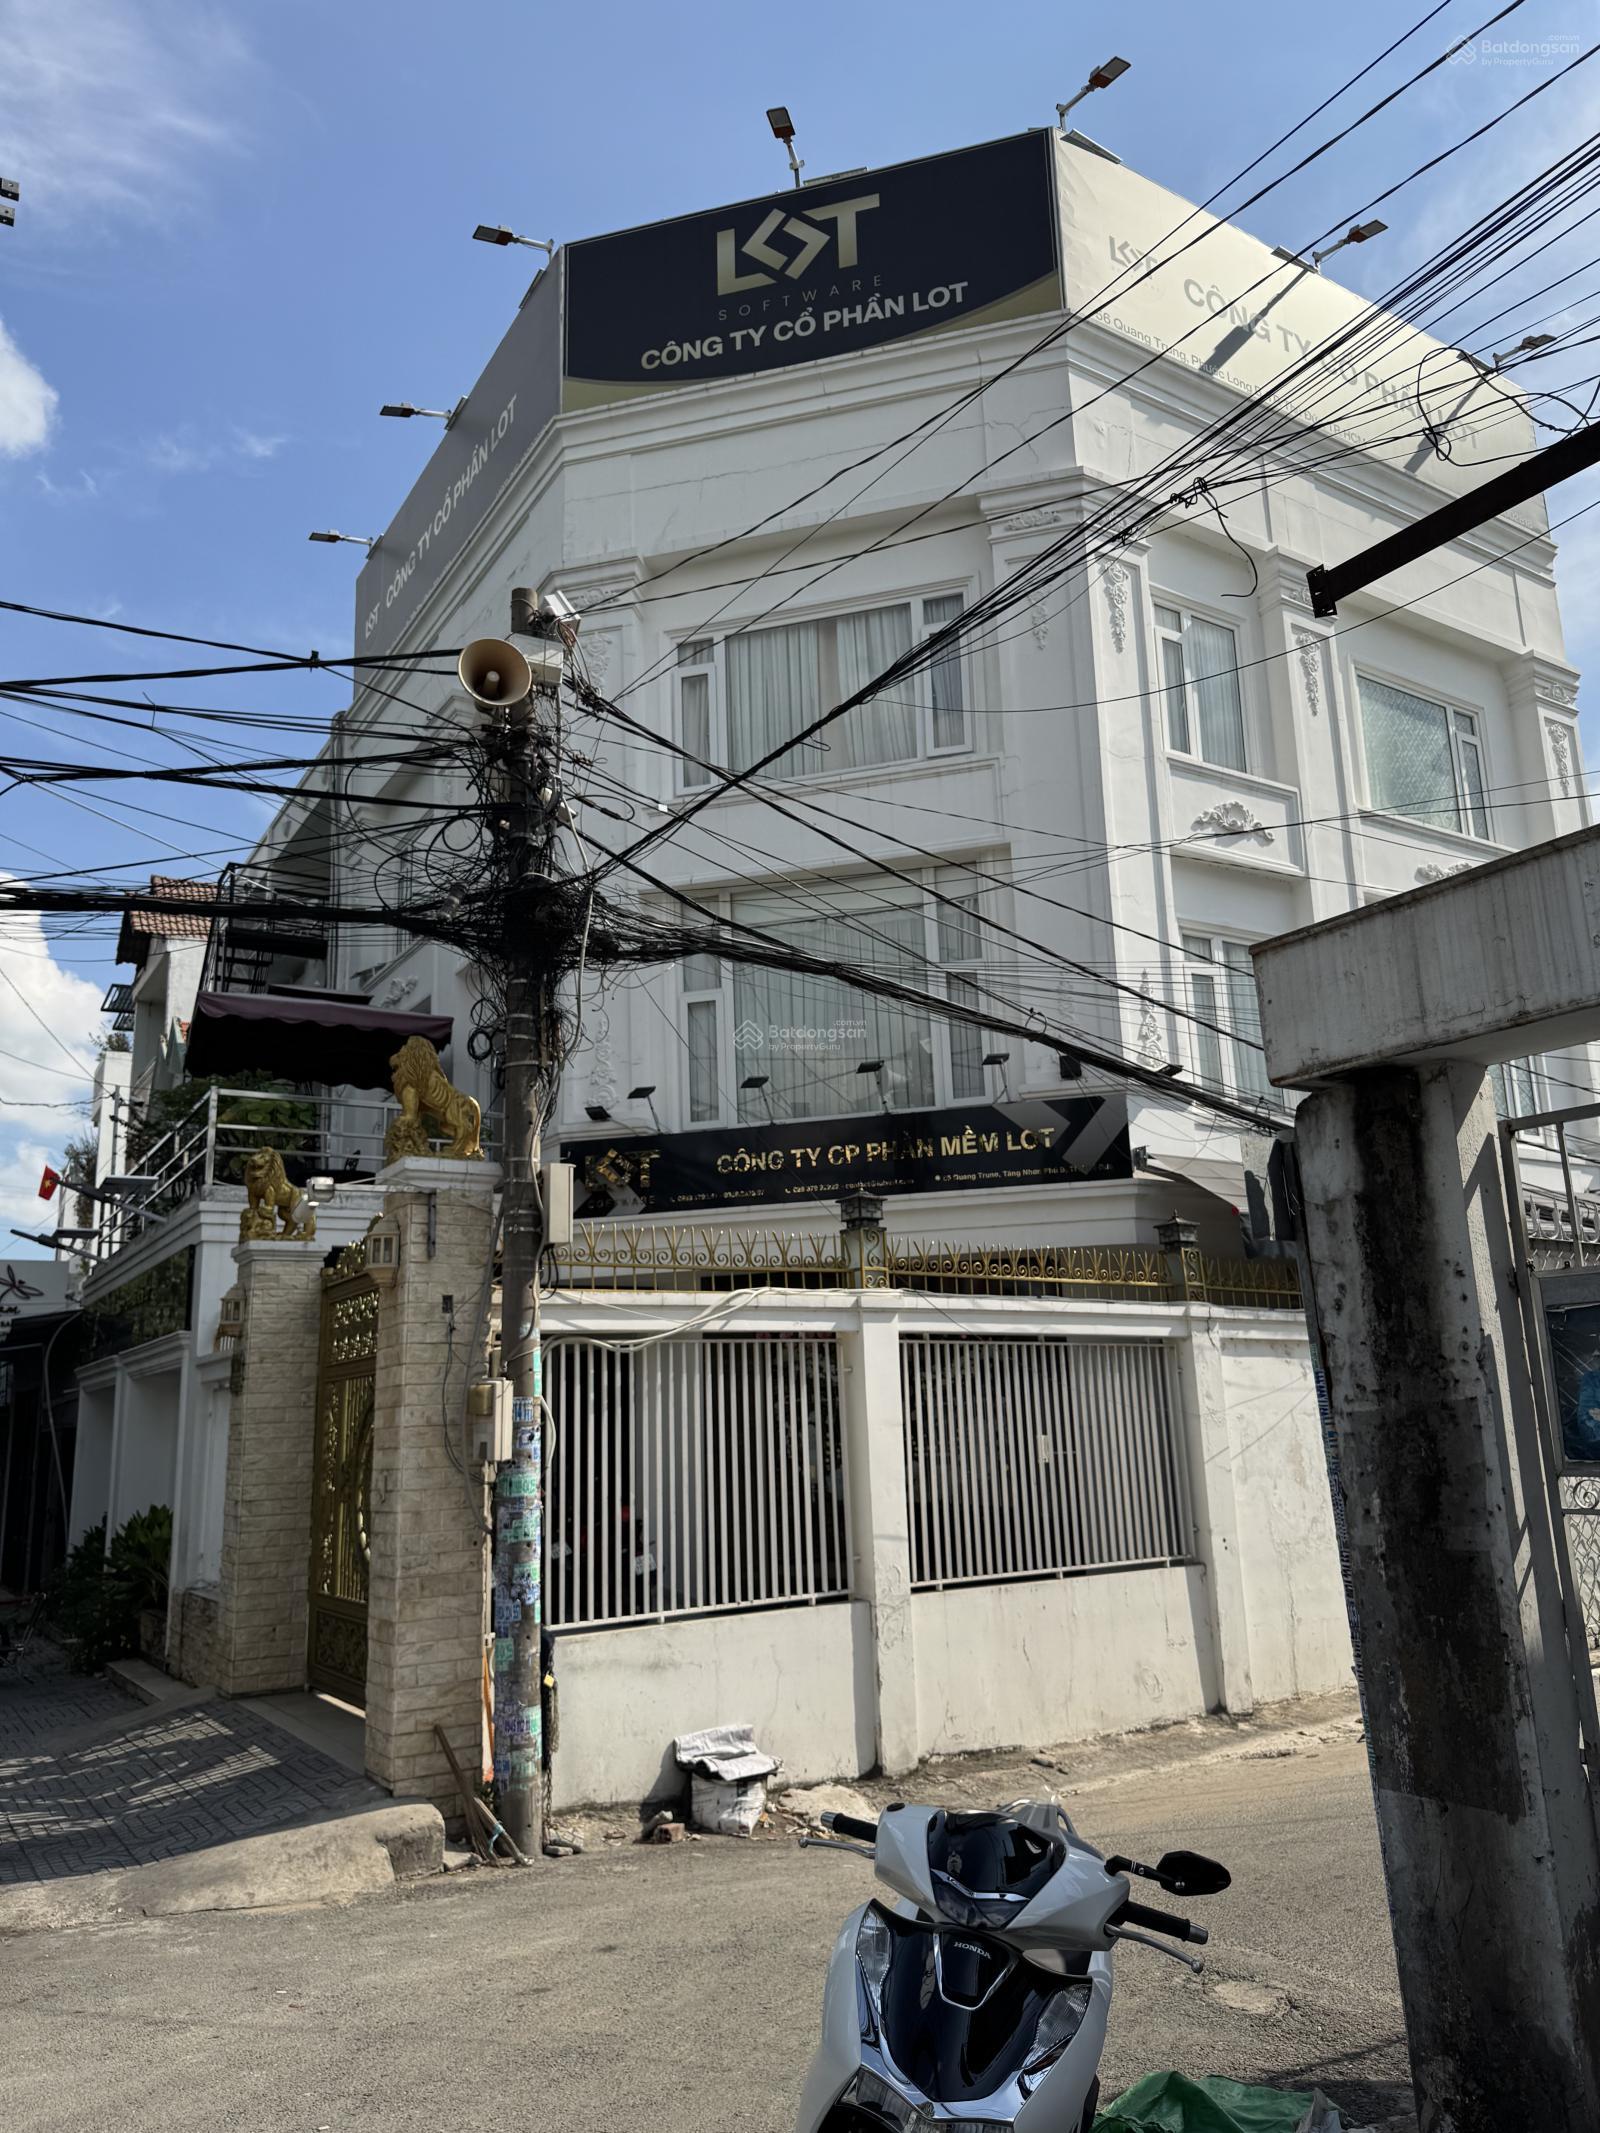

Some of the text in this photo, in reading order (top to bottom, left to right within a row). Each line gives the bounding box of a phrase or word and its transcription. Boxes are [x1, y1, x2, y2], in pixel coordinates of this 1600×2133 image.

[640, 281, 969, 370] CÔNG TY CỔ PHẦN LOT
[718, 275, 881, 321] SOFTWARE
[1113, 318, 1151, 345] Quang
[1227, 371, 1253, 392] Long
[417, 523, 432, 561] TY
[491, 393, 518, 453] LOT
[716, 1148, 784, 1174] CÔNG
[790, 1147, 821, 1168] TY
[1007, 1127, 1055, 1151] LOT
[953, 1941, 992, 1960] HONDA
